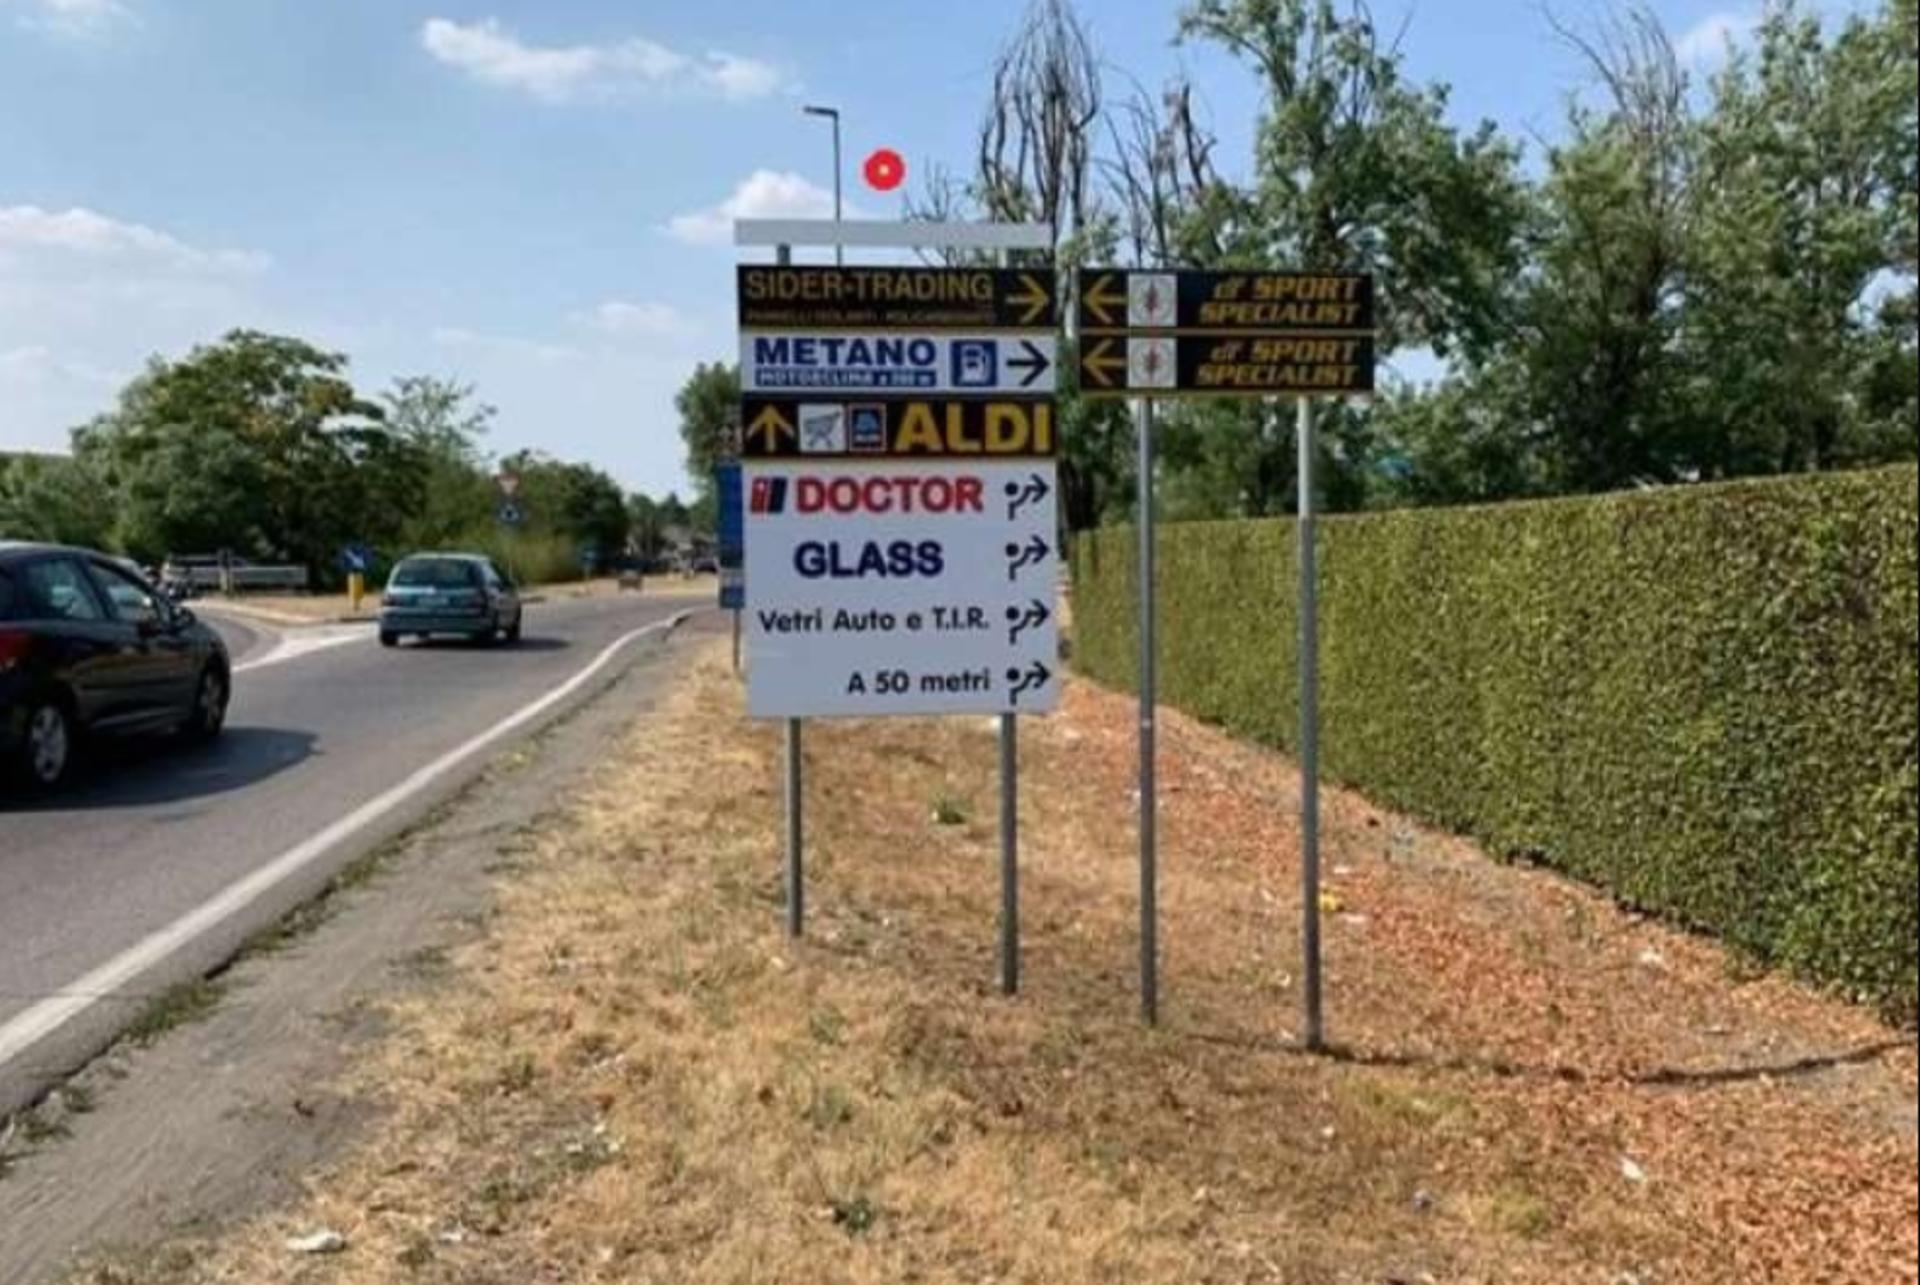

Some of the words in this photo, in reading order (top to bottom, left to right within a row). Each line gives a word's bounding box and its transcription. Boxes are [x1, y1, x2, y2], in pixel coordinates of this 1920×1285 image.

[746, 271, 993, 300] SIDER-TRADING
[1254, 276, 1360, 299] SPORT
[1200, 302, 1361, 323] SPECIALIST
[754, 336, 937, 366] METANO
[1252, 338, 1358, 362] SPORT
[1195, 363, 1360, 385] SPECIALIST
[894, 402, 1050, 452] ALDI
[795, 475, 984, 514] DOCTOR
[793, 540, 945, 578] GLASS
[758, 608, 822, 632] Vetri
[833, 608, 896, 632] Auto
[906, 612, 923, 631] e
[932, 606, 990, 630] T.I.R.
[848, 671, 866, 694] A
[874, 669, 910, 693] 50
[920, 666, 991, 692] metri
